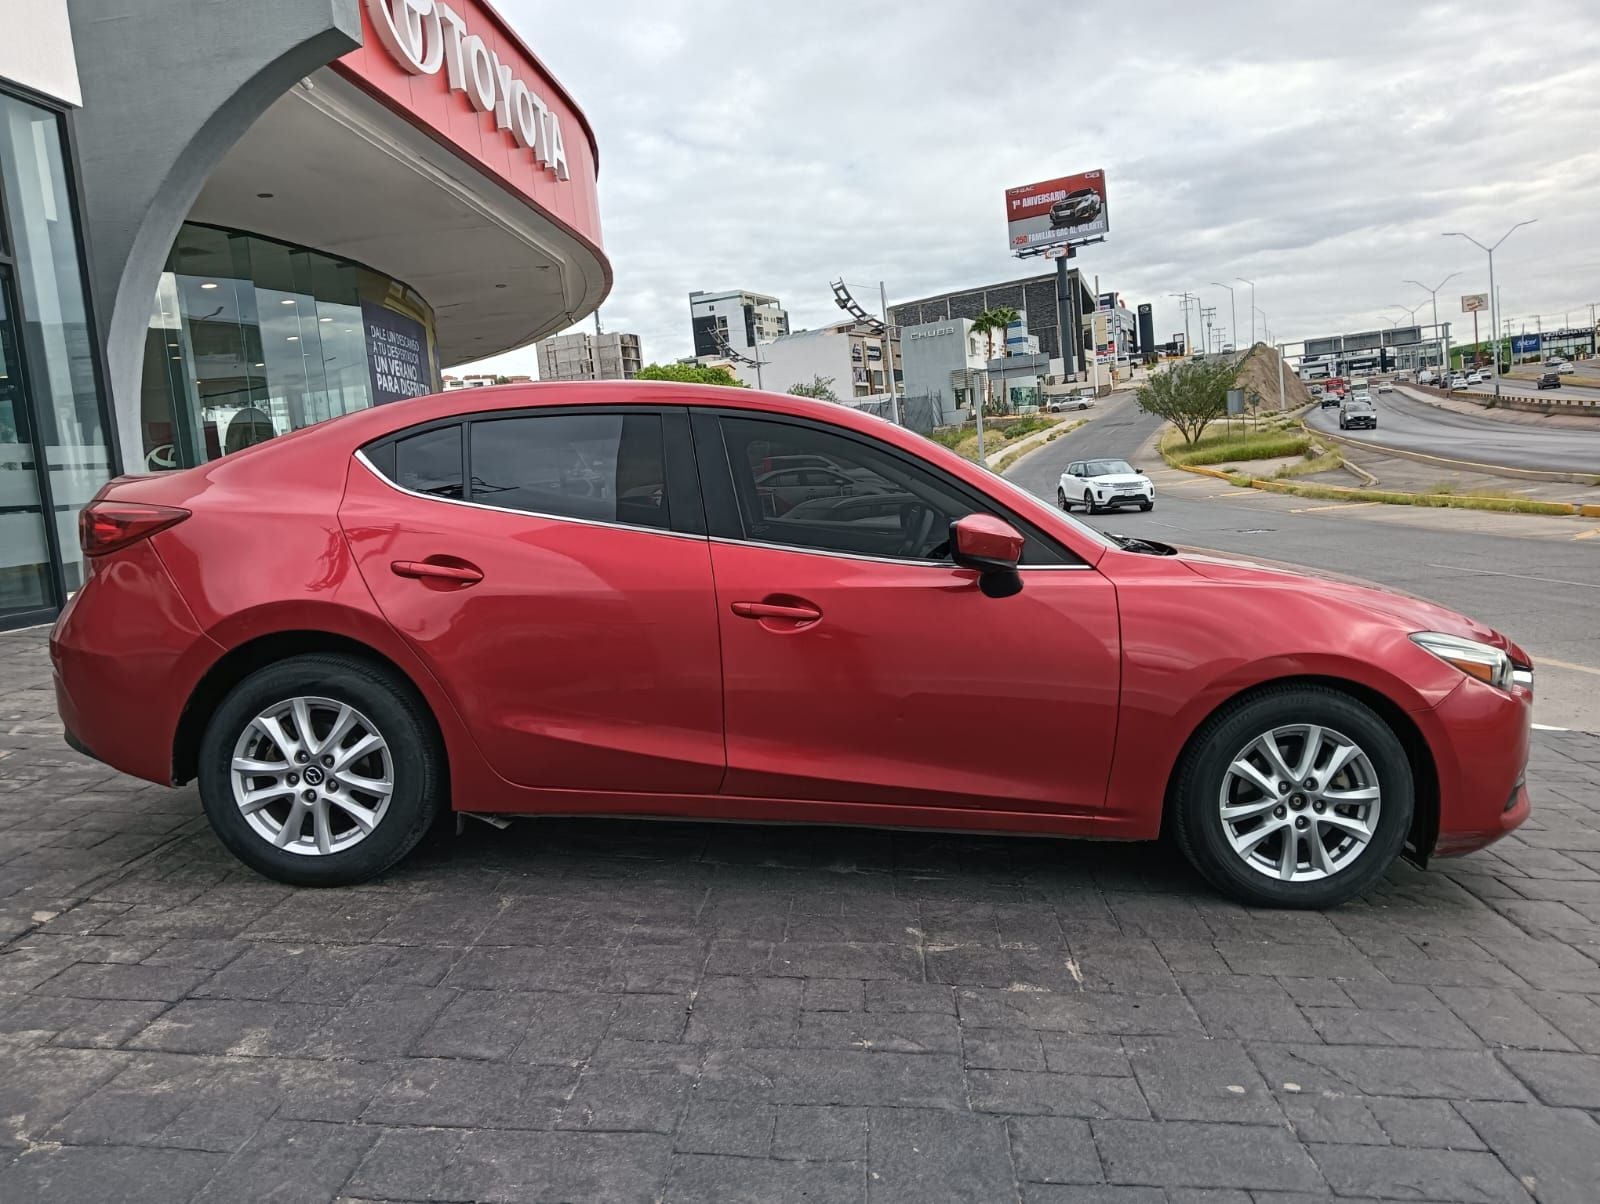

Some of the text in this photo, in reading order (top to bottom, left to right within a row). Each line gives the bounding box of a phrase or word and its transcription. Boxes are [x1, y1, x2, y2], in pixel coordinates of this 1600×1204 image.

[438, 2, 569, 182] TOYOTA
[1023, 190, 1066, 207] ANIVERSARIO
[370, 325, 387, 341] DALE
[387, 330, 396, 344] UN
[373, 340, 378, 354] A
[378, 342, 387, 356] TU
[373, 354, 417, 381] UN VERANO
[376, 373, 400, 393] PARA
